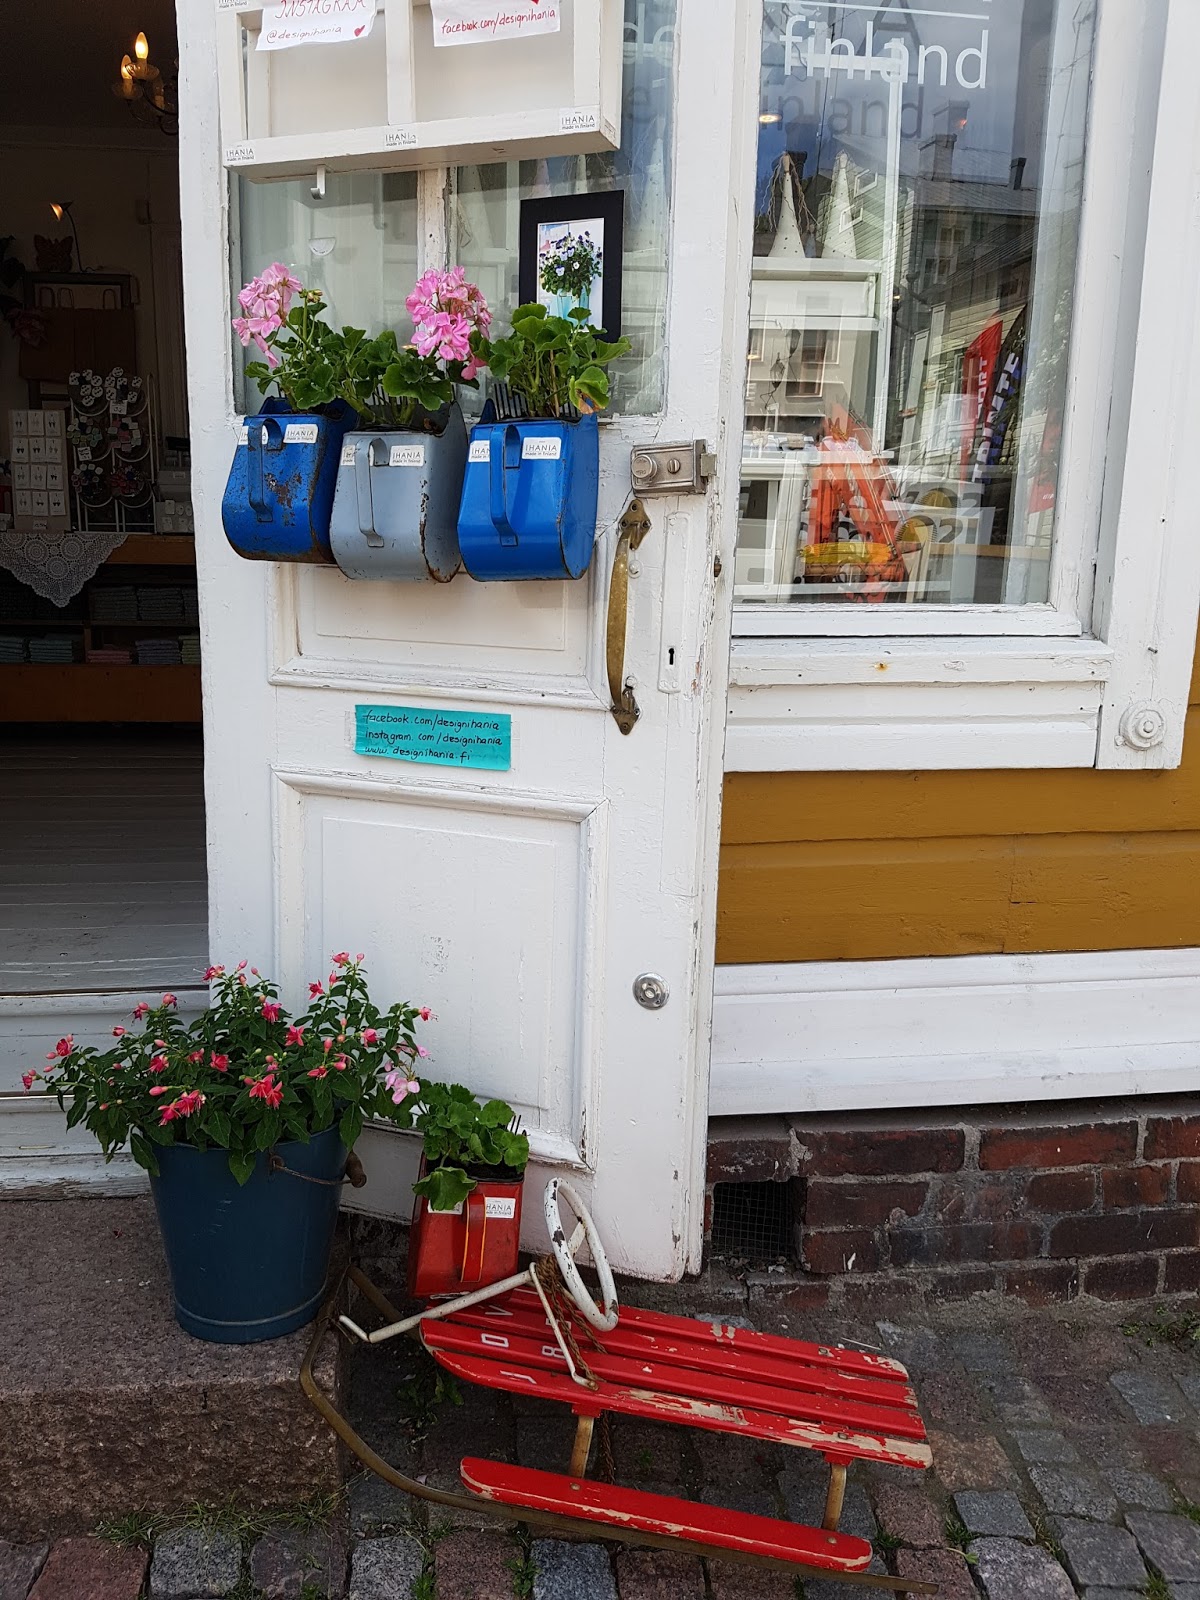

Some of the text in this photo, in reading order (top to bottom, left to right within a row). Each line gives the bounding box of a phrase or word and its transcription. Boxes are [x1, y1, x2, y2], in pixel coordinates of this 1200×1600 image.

[441, 9, 556, 34] facebook.com/designihania
[266, 25, 342, 43] @designihania
[779, 15, 989, 89] finland
[562, 115, 595, 125] IHANIA
[226, 148, 254, 158] IHANIA
[525, 444, 558, 452] IHANIA
[392, 452, 421, 460] IHANIA
[362, 709, 500, 733] facebook.com/designihania
